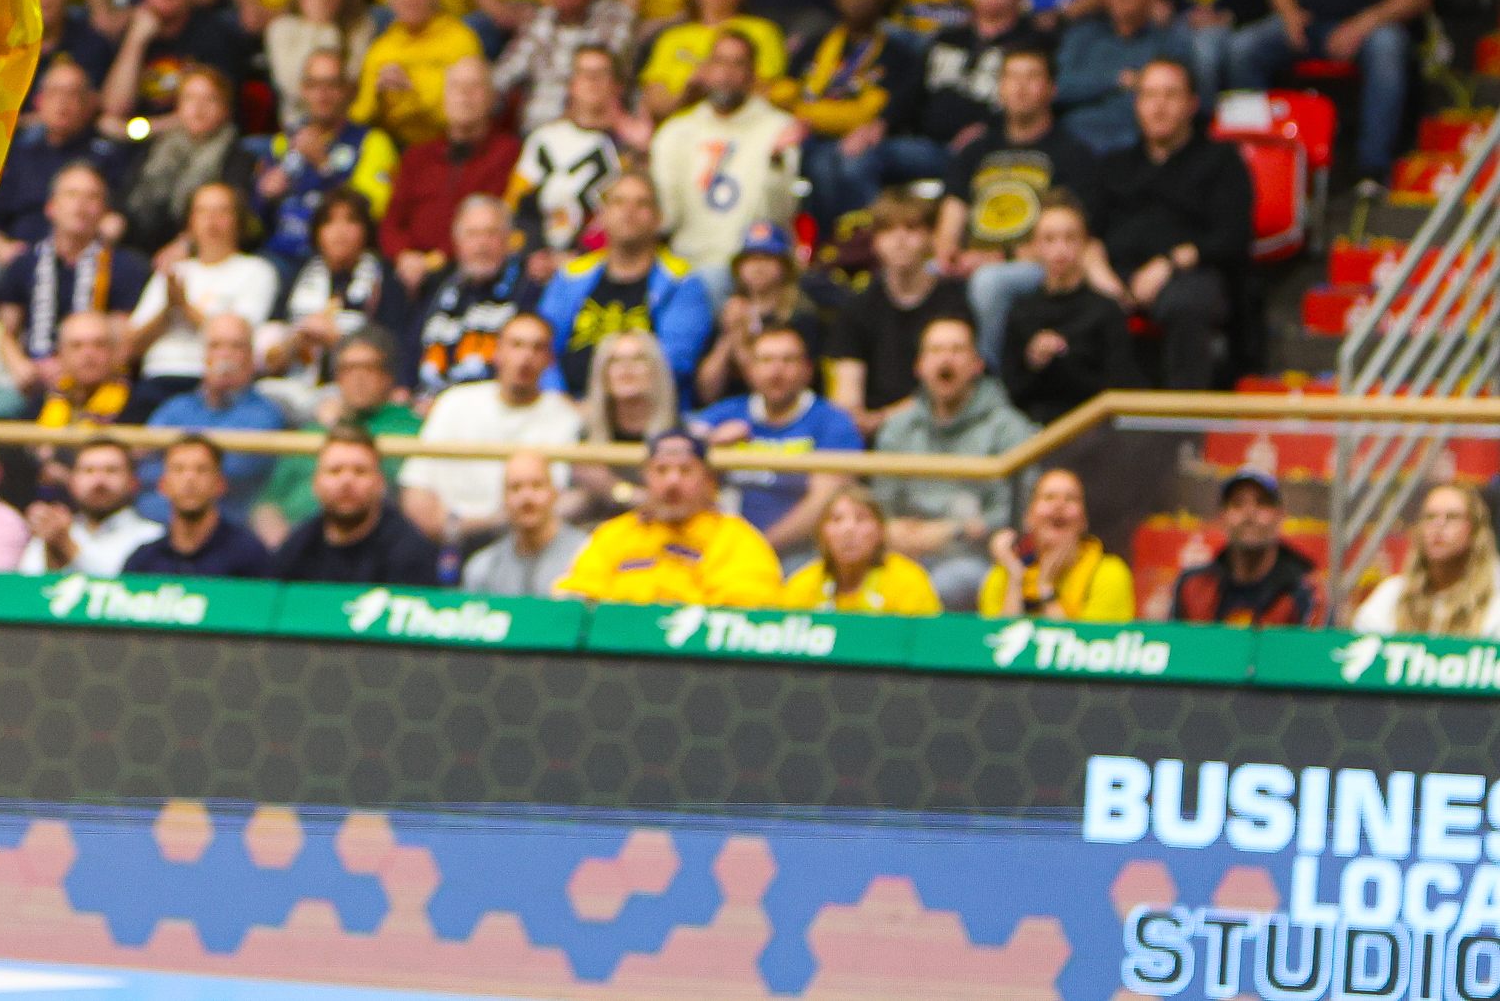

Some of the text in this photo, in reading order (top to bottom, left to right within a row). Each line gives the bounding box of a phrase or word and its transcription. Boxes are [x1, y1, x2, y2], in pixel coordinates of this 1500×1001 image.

[88, 576, 209, 626] Thalia
[387, 595, 513, 644] Thalia
[704, 609, 837, 657] Thalia
[1033, 626, 1172, 676] Thalia
[1381, 642, 1500, 690] Thali
[1083, 754, 1500, 864] BUSINE
